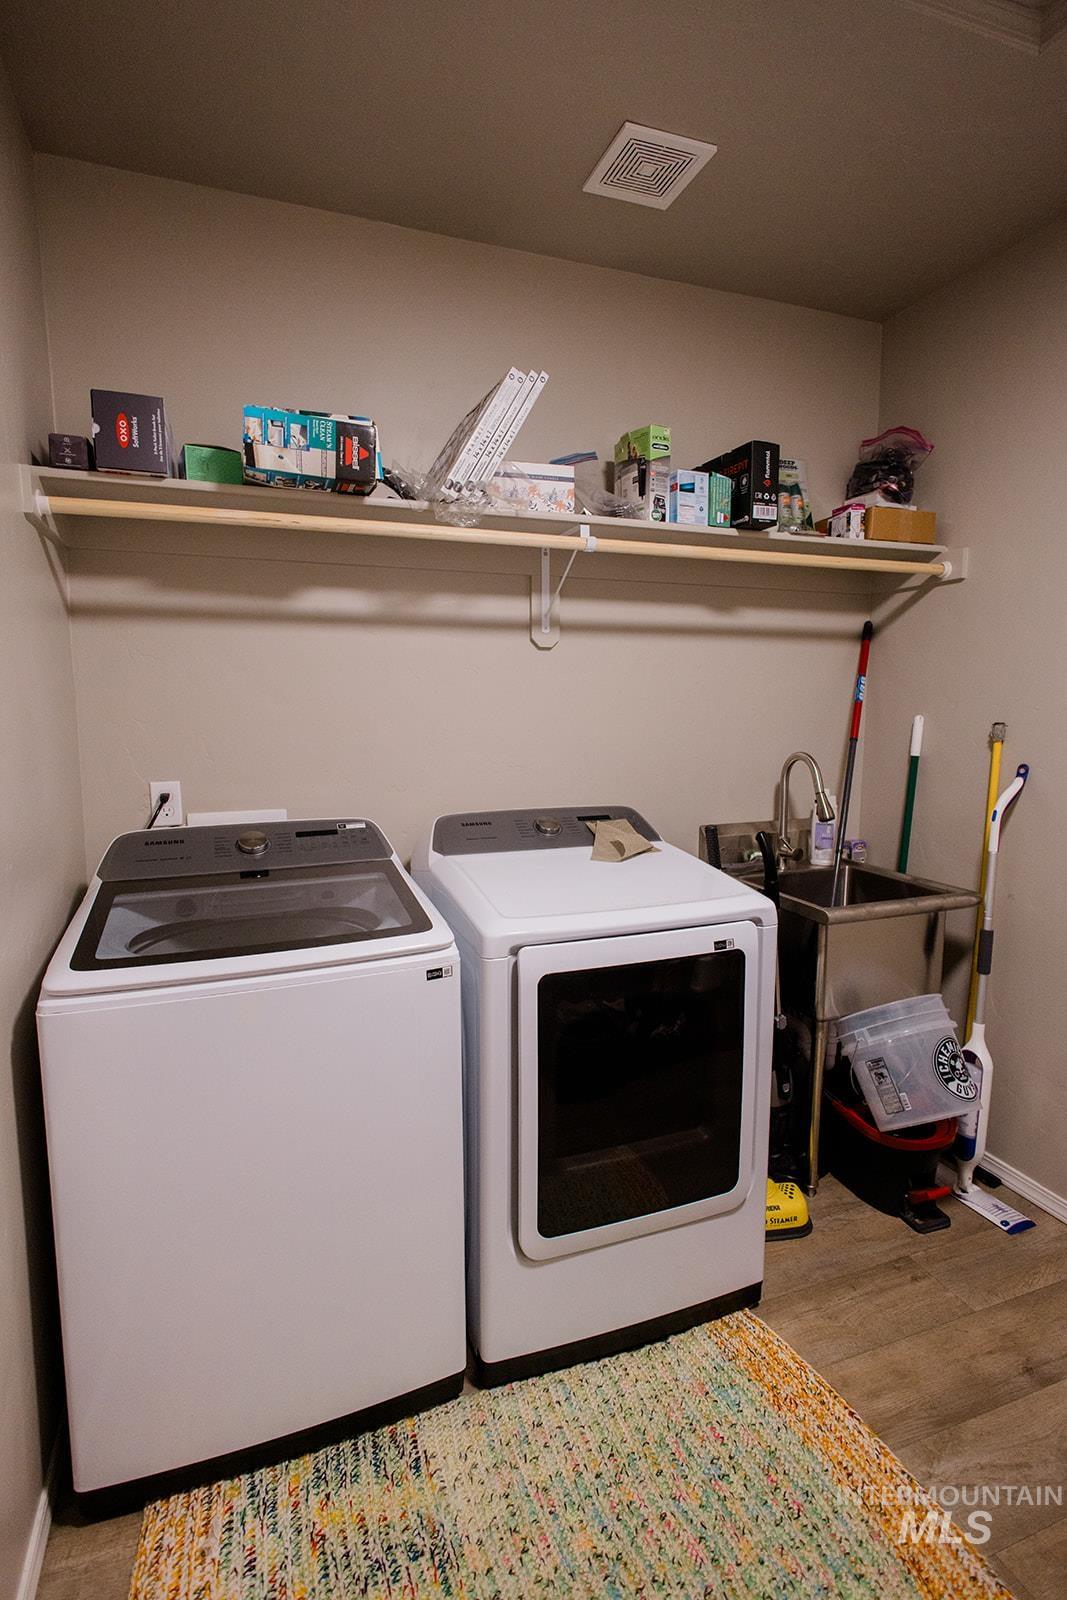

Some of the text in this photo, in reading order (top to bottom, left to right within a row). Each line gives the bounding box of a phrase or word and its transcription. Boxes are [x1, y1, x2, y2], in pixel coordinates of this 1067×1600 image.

[119, 420, 128, 442] OXO
[131, 416, 139, 448] SoftWorks
[770, 1216, 797, 1224] STEAMER
